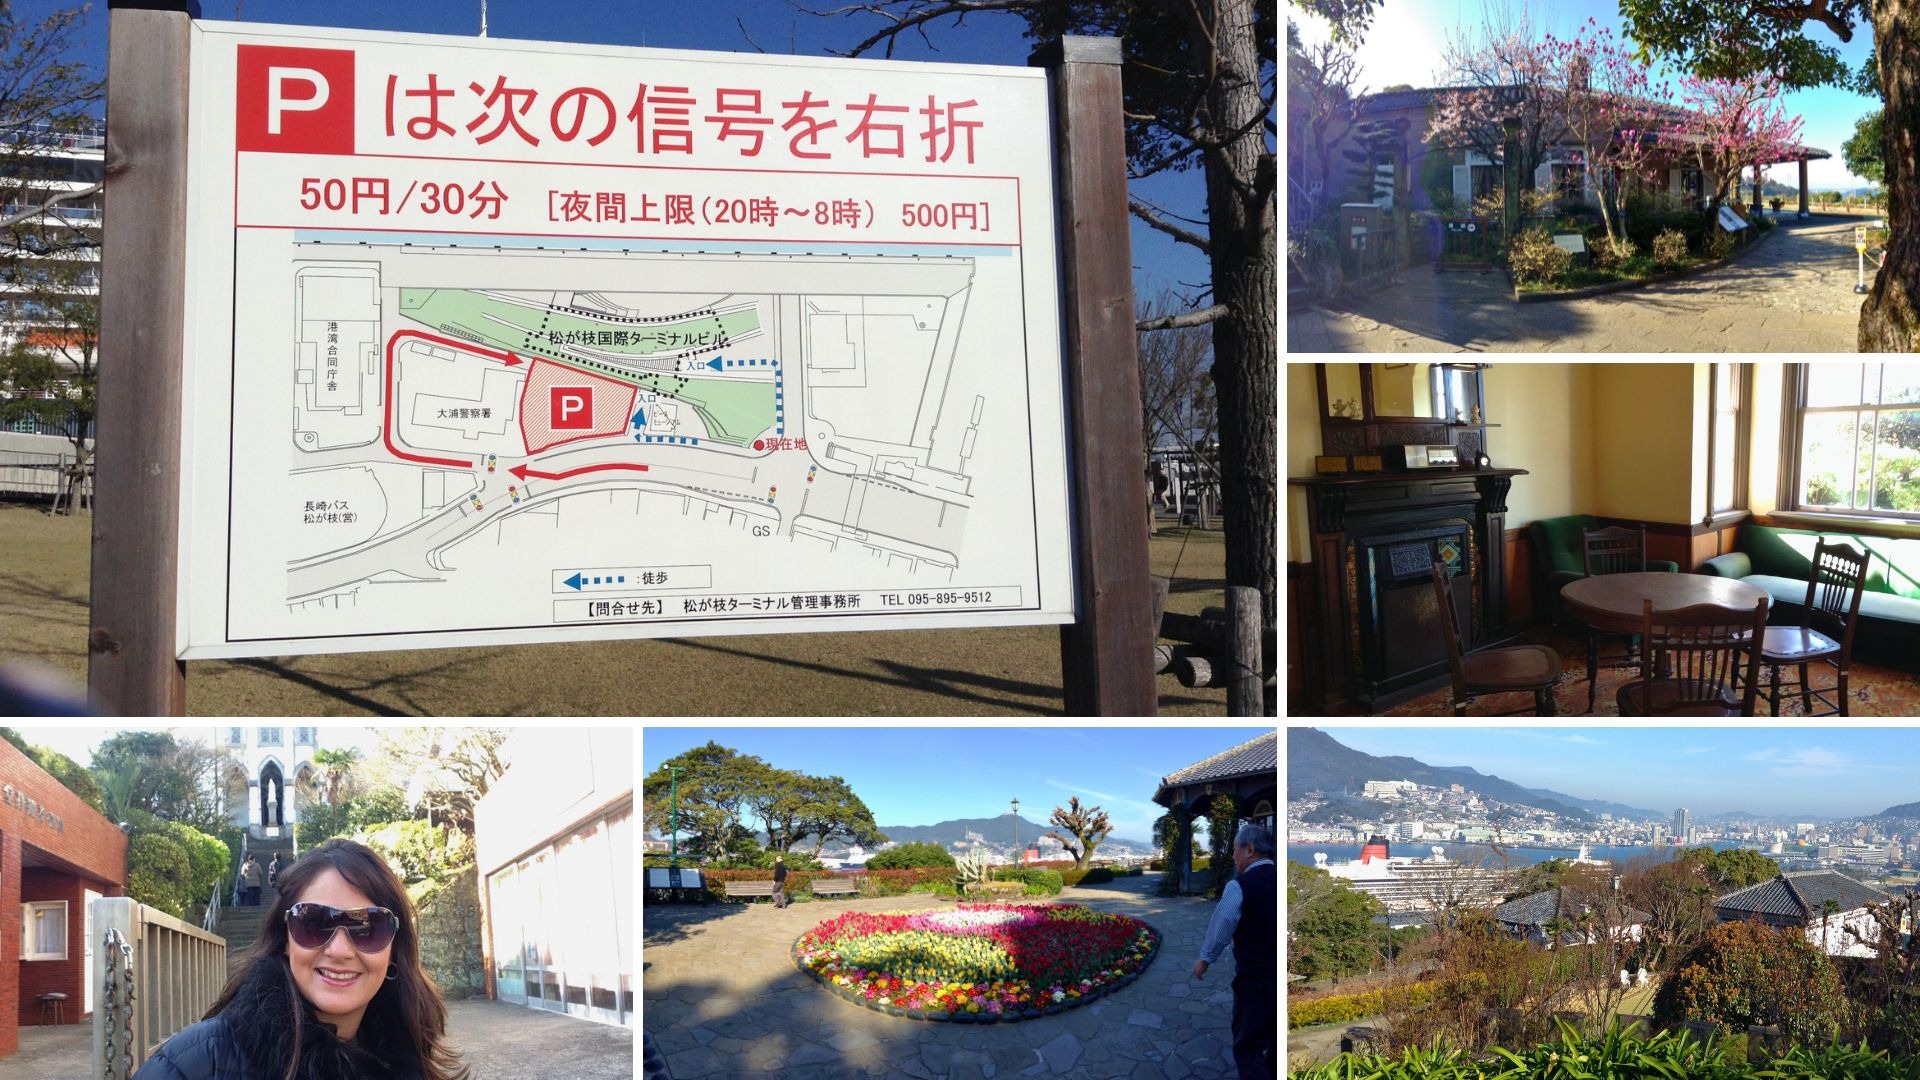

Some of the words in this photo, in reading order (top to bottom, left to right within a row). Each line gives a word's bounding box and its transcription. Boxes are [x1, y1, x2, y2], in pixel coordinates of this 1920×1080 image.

[267, 66, 330, 135] P
[385, 74, 984, 164] は次の信号を右折
[300, 176, 509, 219] 50円/30分
[548, 329, 726, 347] 松が枝国際ターミナルビル
[326, 321, 339, 392] 港湾合同庁舎
[687, 361, 706, 371] 入口
[637, 393, 657, 403] 入口
[436, 407, 493, 420] 大浦警察署
[561, 394, 585, 422] P
[765, 437, 808, 452] 現在地
[304, 500, 349, 512] 長崎バス
[303, 512, 358, 524] 松が枝(営)
[752, 525, 771, 537] GS
[585, 599, 664, 619] 【問合せ先】
[683, 593, 861, 614] 松が枝ターミナル管理事務所
[880, 594, 905, 607] TEL
[907, 590, 992, 606] 095-895-9512
